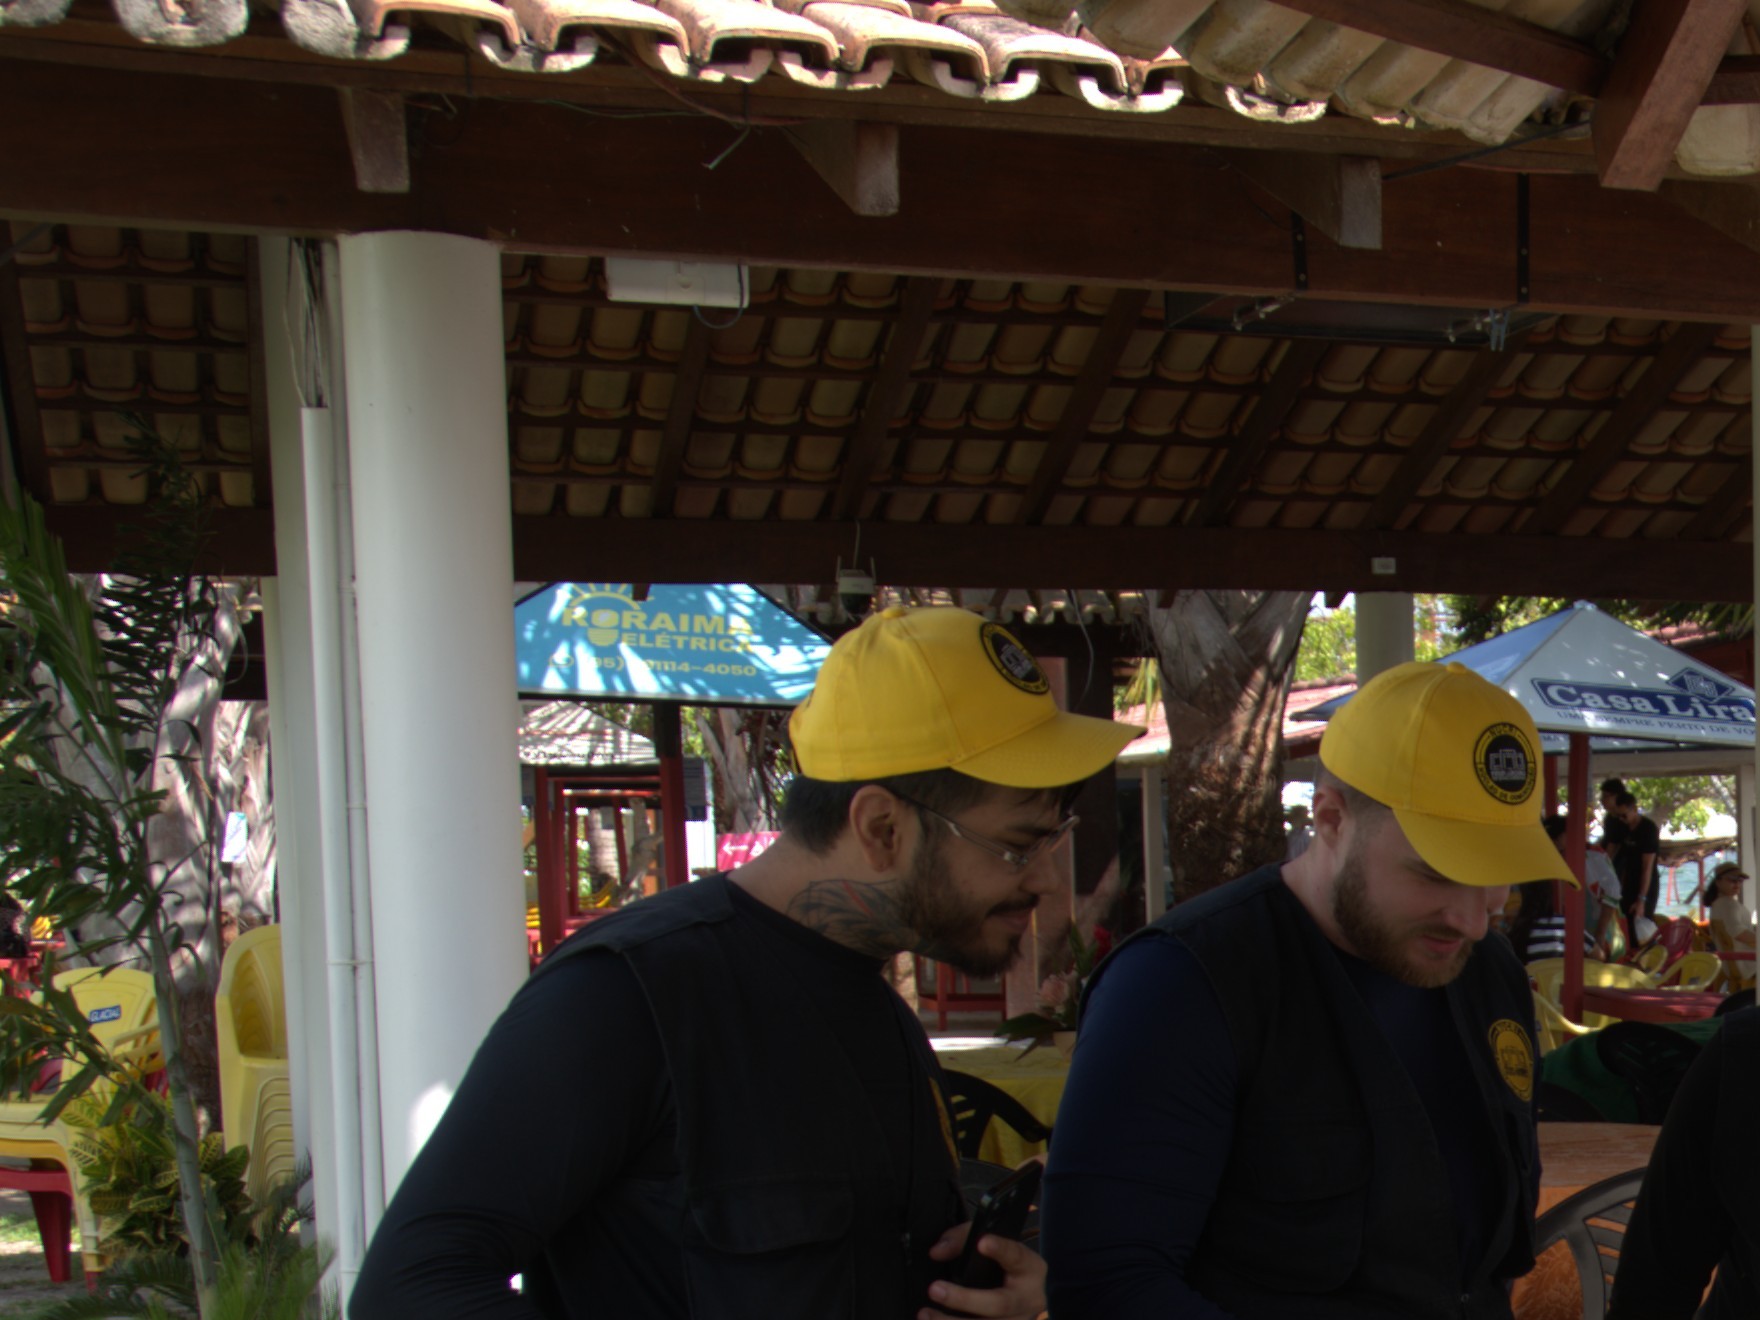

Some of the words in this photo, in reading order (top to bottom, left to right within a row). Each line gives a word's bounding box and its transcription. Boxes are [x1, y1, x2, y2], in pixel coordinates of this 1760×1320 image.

[561, 607, 754, 635] RORAIMA
[621, 631, 755, 653] ELÉTRICA
[1546, 684, 1661, 714] Casa
[1656, 694, 1756, 723] Lira
[1732, 727, 1755, 736] VO
